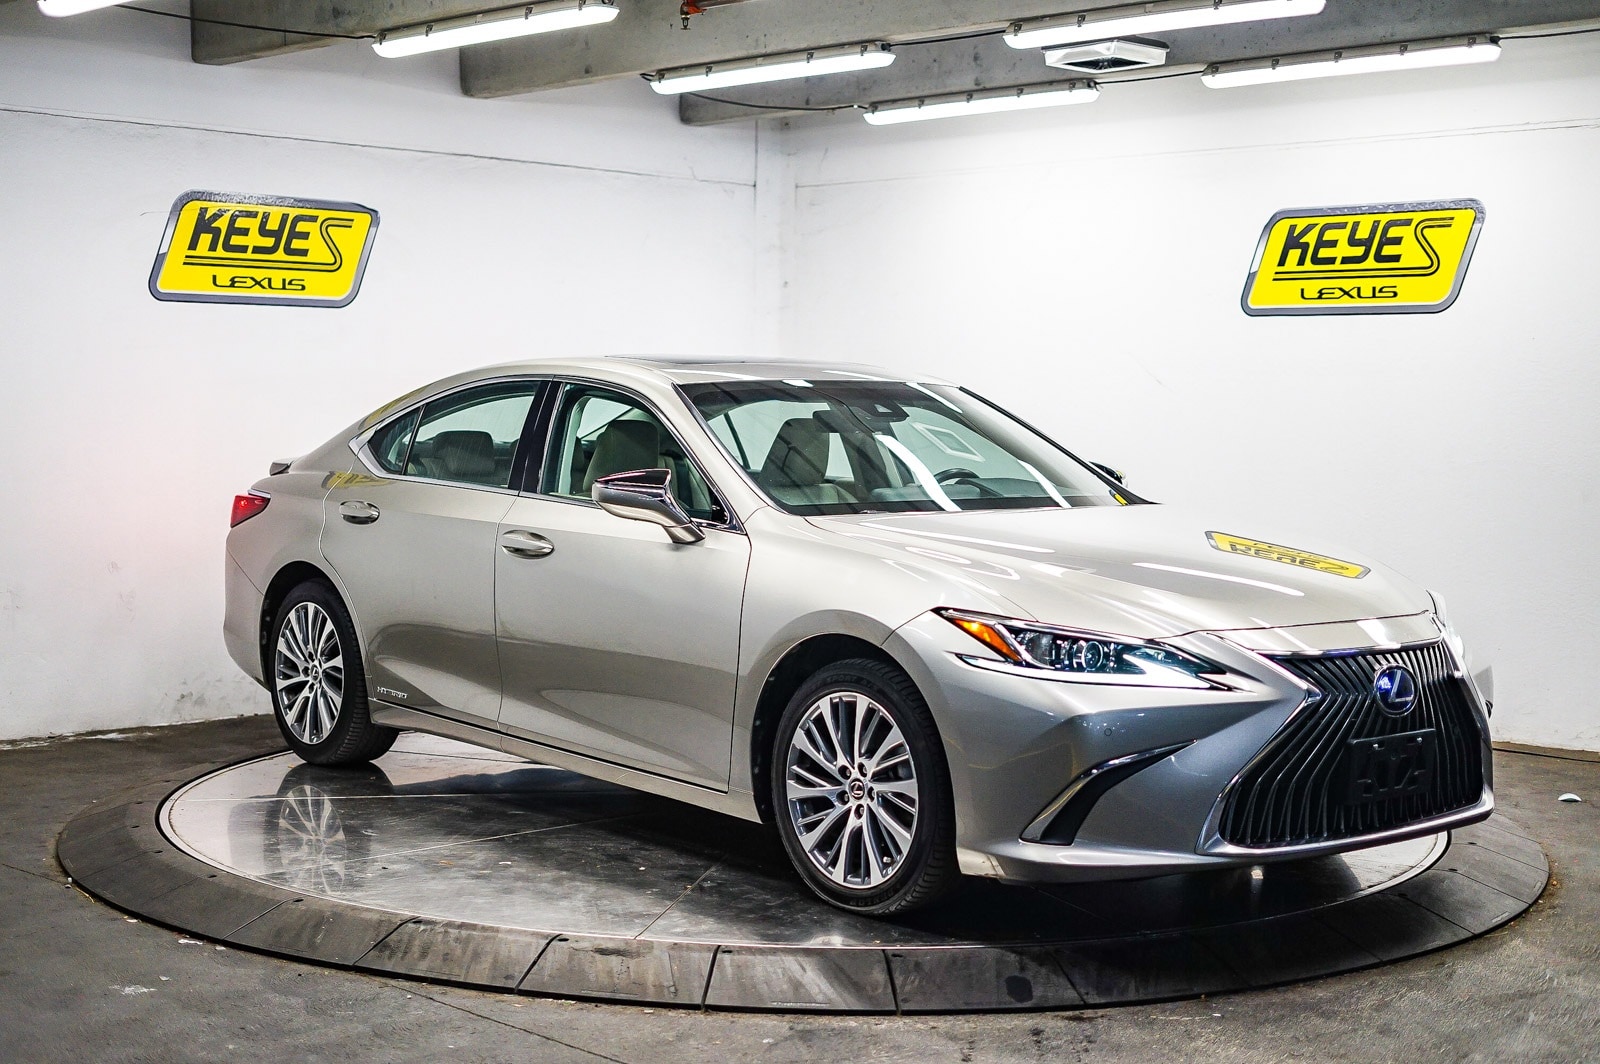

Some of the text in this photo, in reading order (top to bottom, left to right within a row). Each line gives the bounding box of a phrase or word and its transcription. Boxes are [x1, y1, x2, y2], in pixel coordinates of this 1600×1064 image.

[184, 206, 355, 273] KEYES
[1274, 216, 1455, 277] KEYES
[211, 274, 306, 291] LEXUS
[1300, 285, 1399, 301] LEXUS
